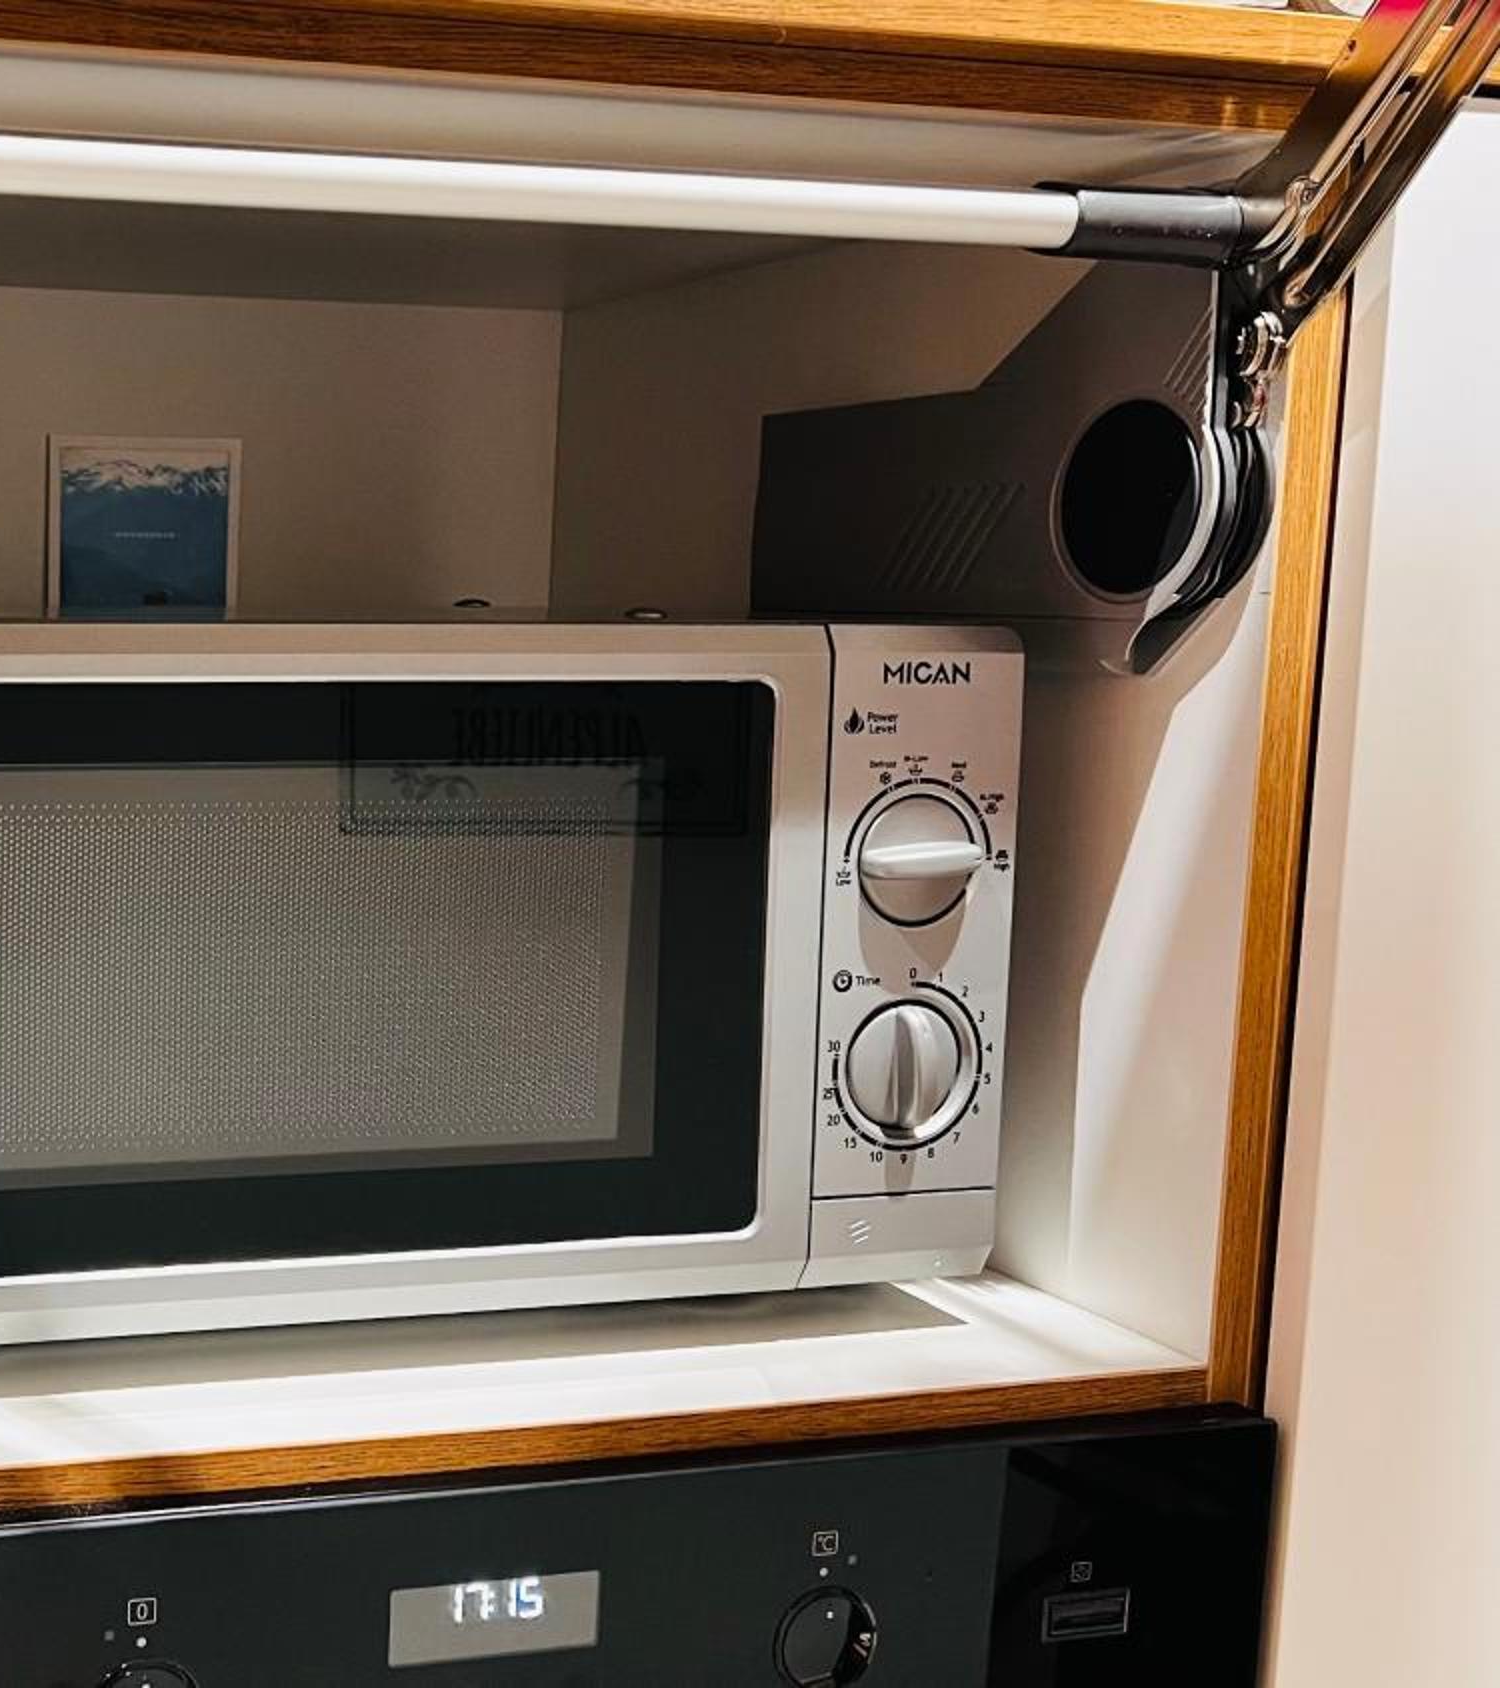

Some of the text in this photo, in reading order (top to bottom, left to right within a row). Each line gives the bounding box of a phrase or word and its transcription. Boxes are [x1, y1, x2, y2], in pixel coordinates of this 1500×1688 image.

[883, 661, 970, 684] MICAN
[867, 711, 898, 722] Power
[869, 723, 897, 735] Level
[909, 967, 917, 979] 0
[938, 971, 943, 982] 1
[855, 975, 881, 986] Time
[962, 985, 969, 997] 2
[979, 1010, 985, 1023] 3
[827, 1039, 841, 1053] 30
[985, 1042, 993, 1054] 4
[983, 1072, 991, 1085] 5
[823, 1086, 836, 1100] 25
[972, 1102, 980, 1115] 6
[827, 1114, 841, 1127] 20
[843, 1137, 857, 1149] 15
[953, 1131, 961, 1144] 7
[869, 1151, 883, 1163] 10
[900, 1153, 908, 1165] 9
[927, 1147, 935, 1159] 8
[453, 1576, 544, 1623] 17:15
